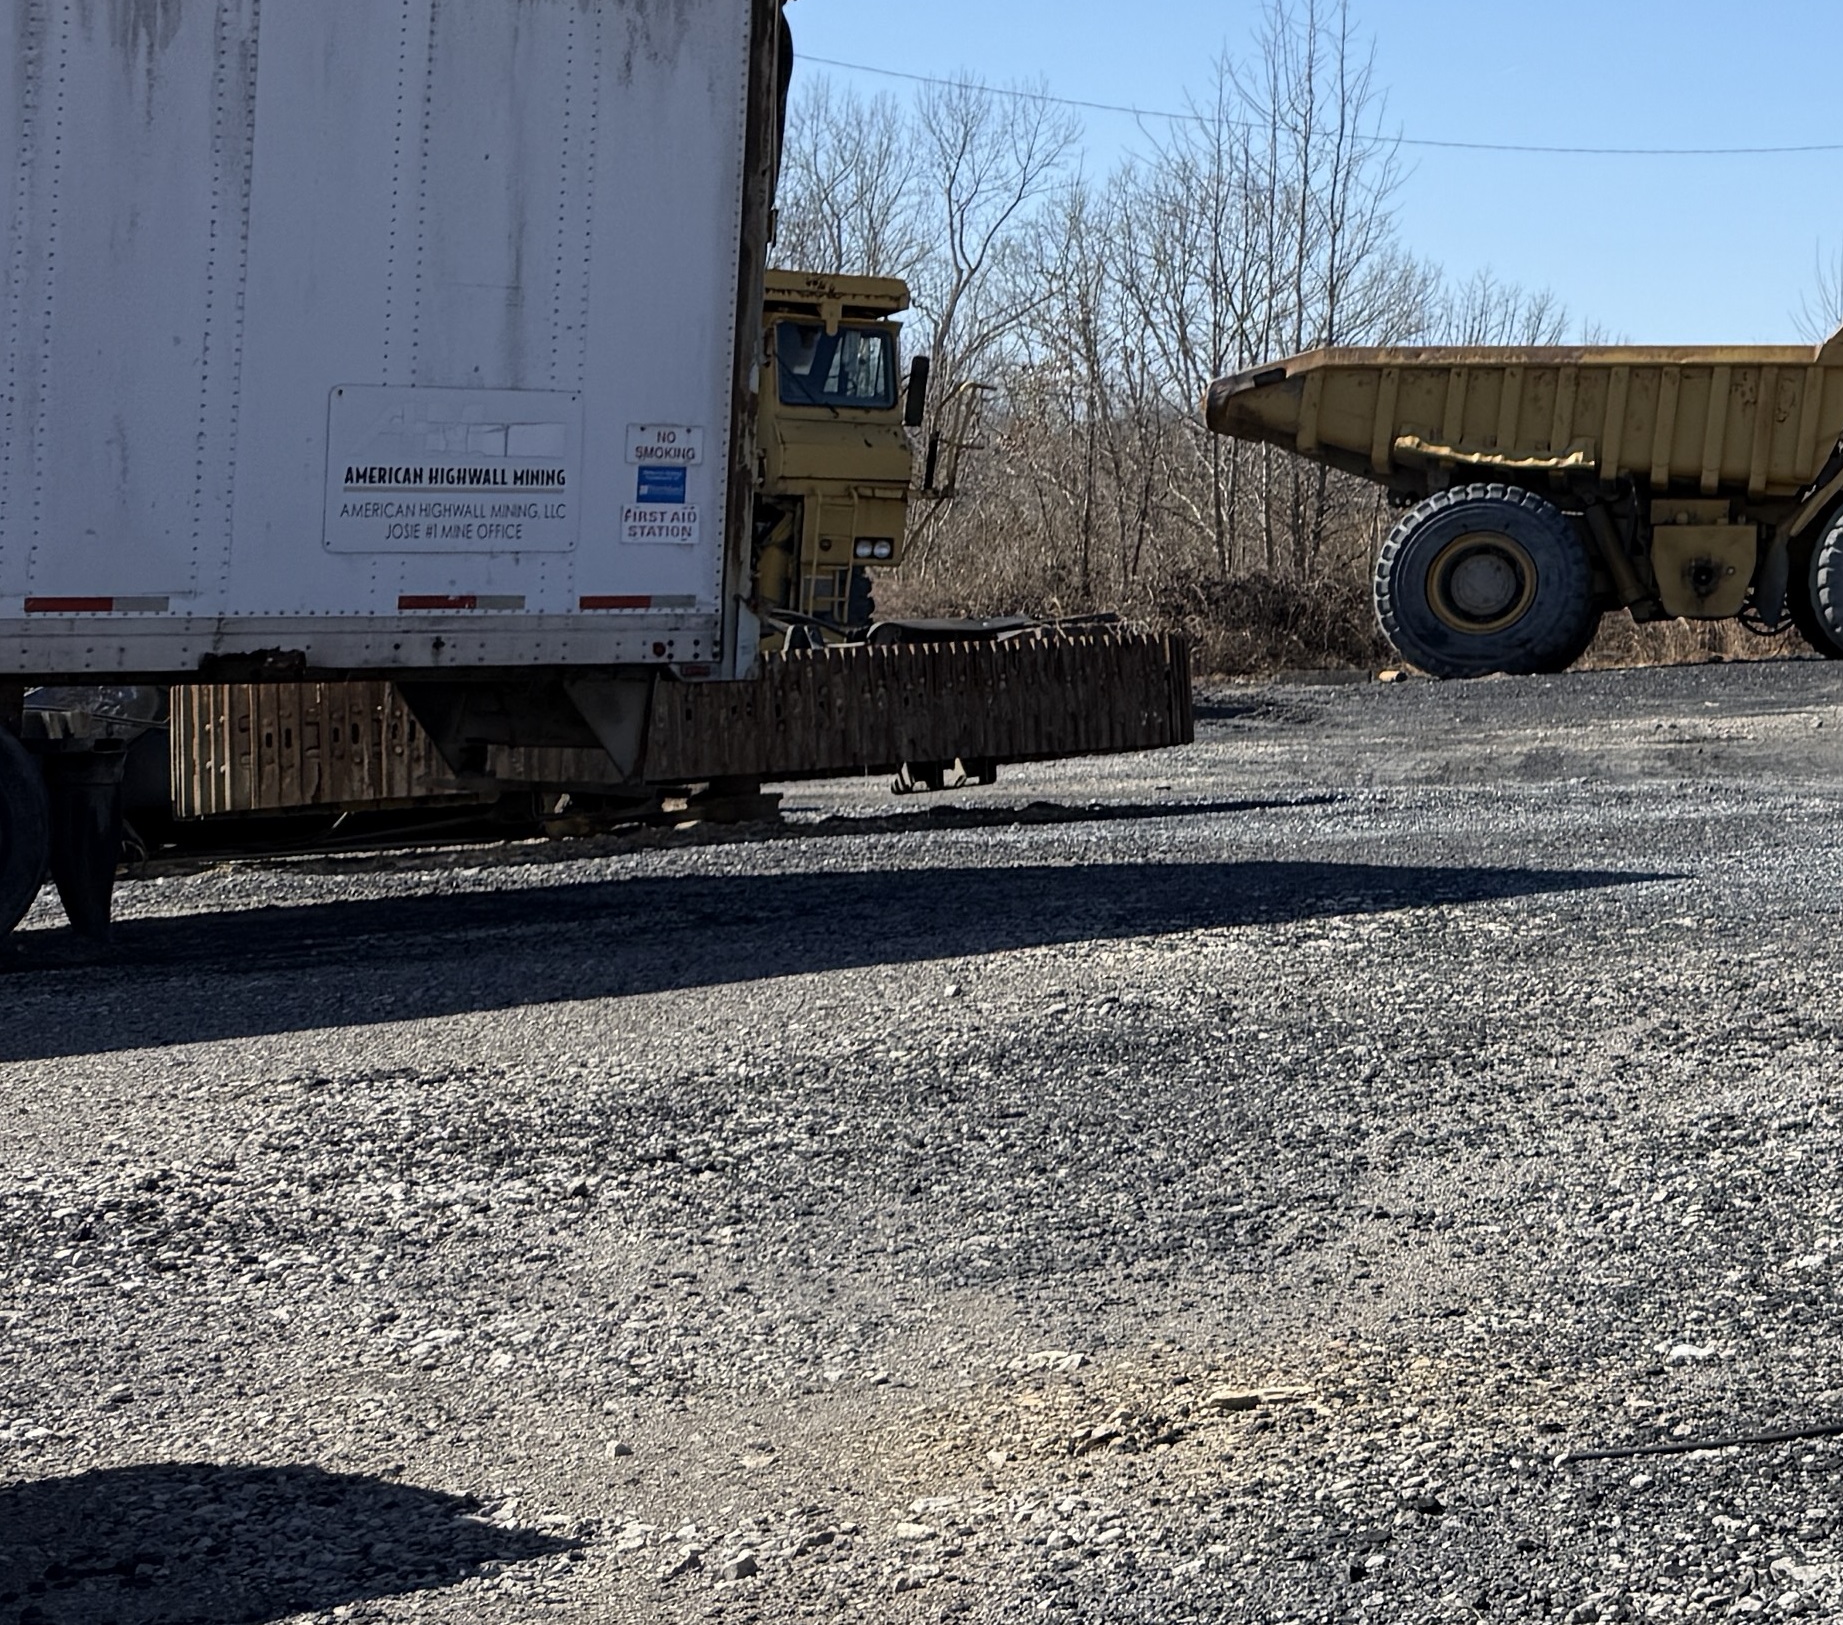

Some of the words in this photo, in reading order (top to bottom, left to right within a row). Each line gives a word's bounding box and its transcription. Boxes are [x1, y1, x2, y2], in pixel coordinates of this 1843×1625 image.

[657, 431, 676, 443] NO
[635, 446, 695, 460] SMOKING
[344, 466, 423, 484] AMERICAN
[428, 467, 508, 485] HIGHWALL
[513, 469, 566, 486] MINING
[340, 502, 416, 518] AMERICAN
[419, 503, 486, 519] HIGHWALL
[490, 503, 541, 520] MINING,
[544, 504, 566, 519] LLC
[624, 508, 667, 523] FIRST
[670, 511, 697, 523] AID
[385, 523, 421, 540] JOSIE
[425, 523, 438, 539] #1
[441, 524, 474, 539] MINE
[477, 524, 522, 540] OFFICE
[627, 525, 692, 538] STATION
